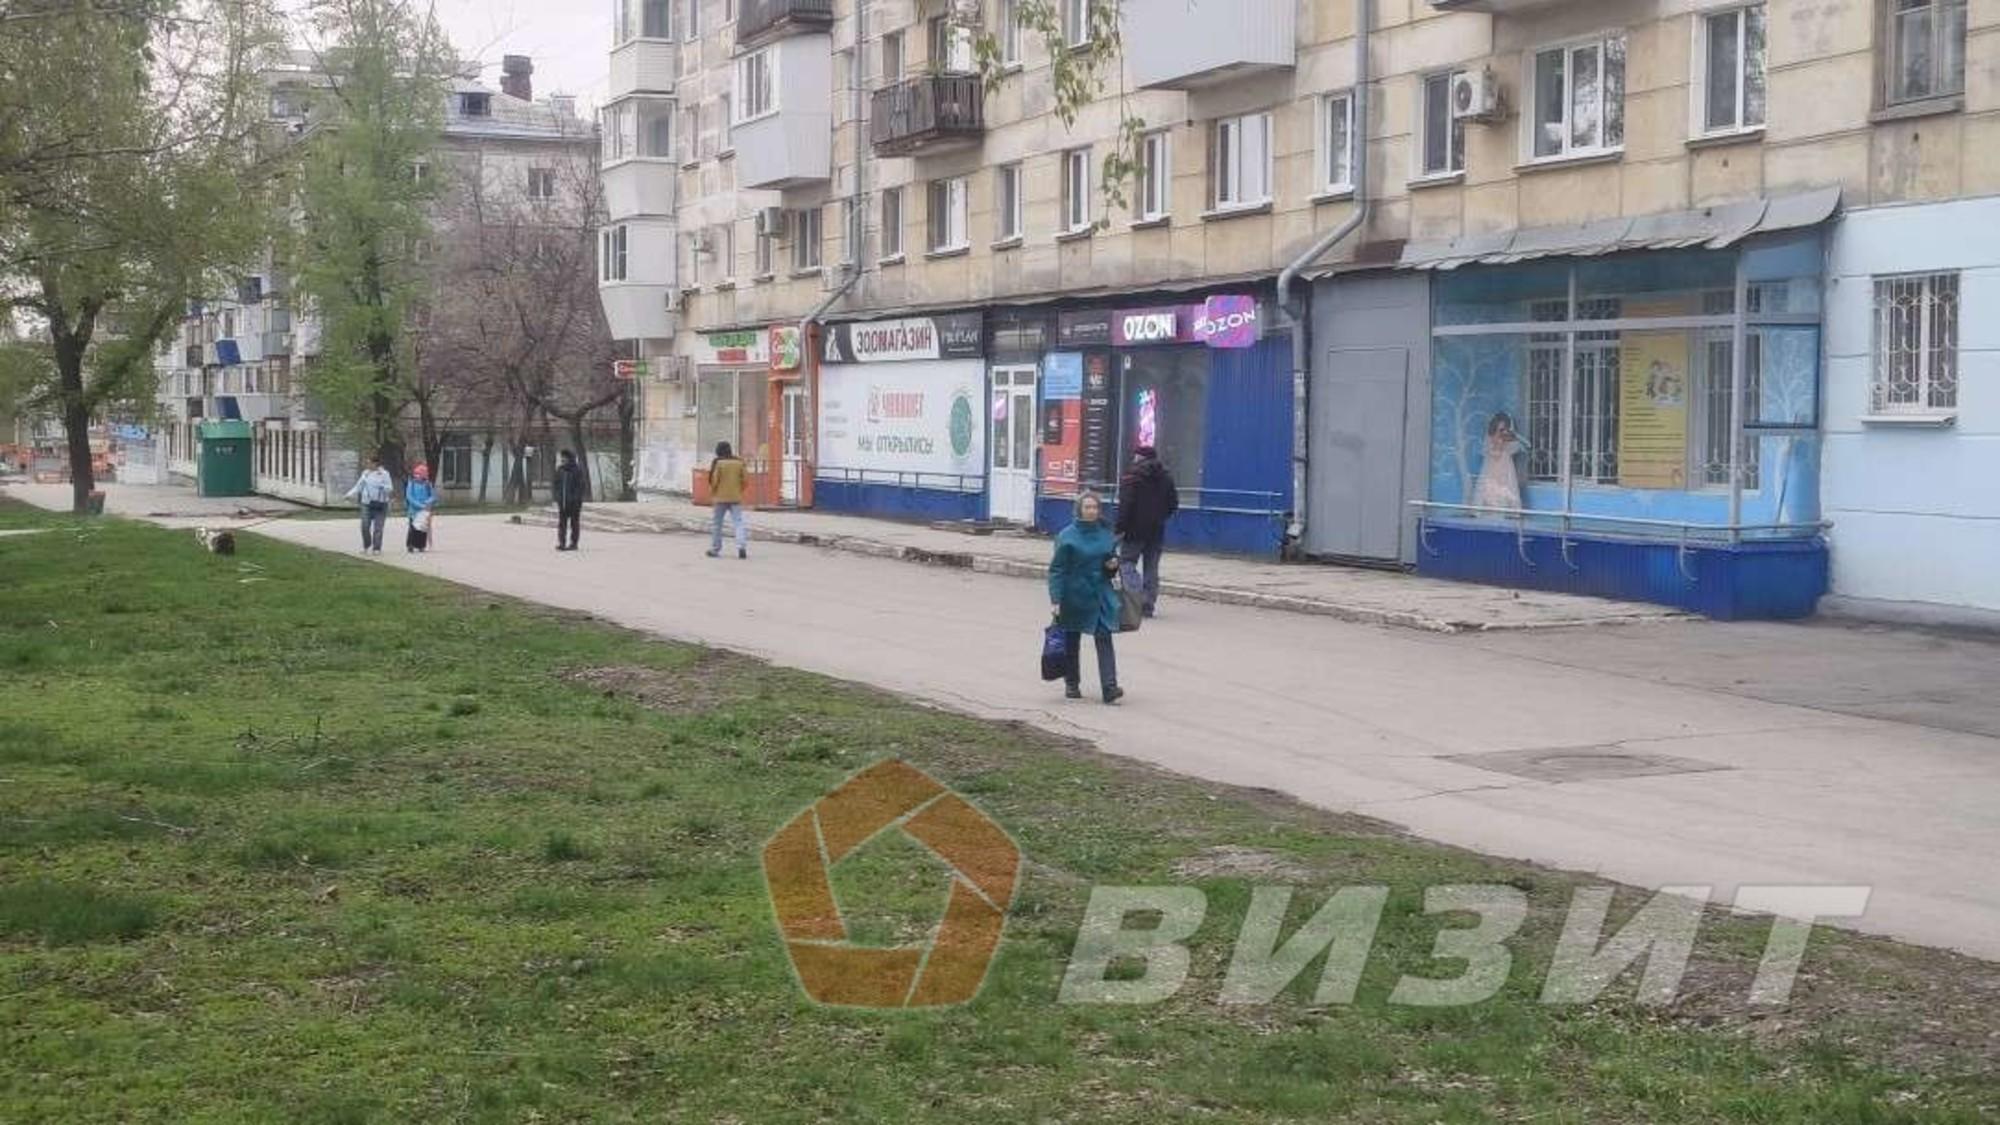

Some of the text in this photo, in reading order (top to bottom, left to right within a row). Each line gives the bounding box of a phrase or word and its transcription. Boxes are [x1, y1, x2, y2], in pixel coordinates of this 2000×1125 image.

[1123, 313, 1176, 341] OZON
[1202, 309, 1256, 335] OZON
[855, 326, 932, 353] ЗООМАГАЗИН
[858, 435, 934, 455] МЫ ОТКРЫЛИСЬ
